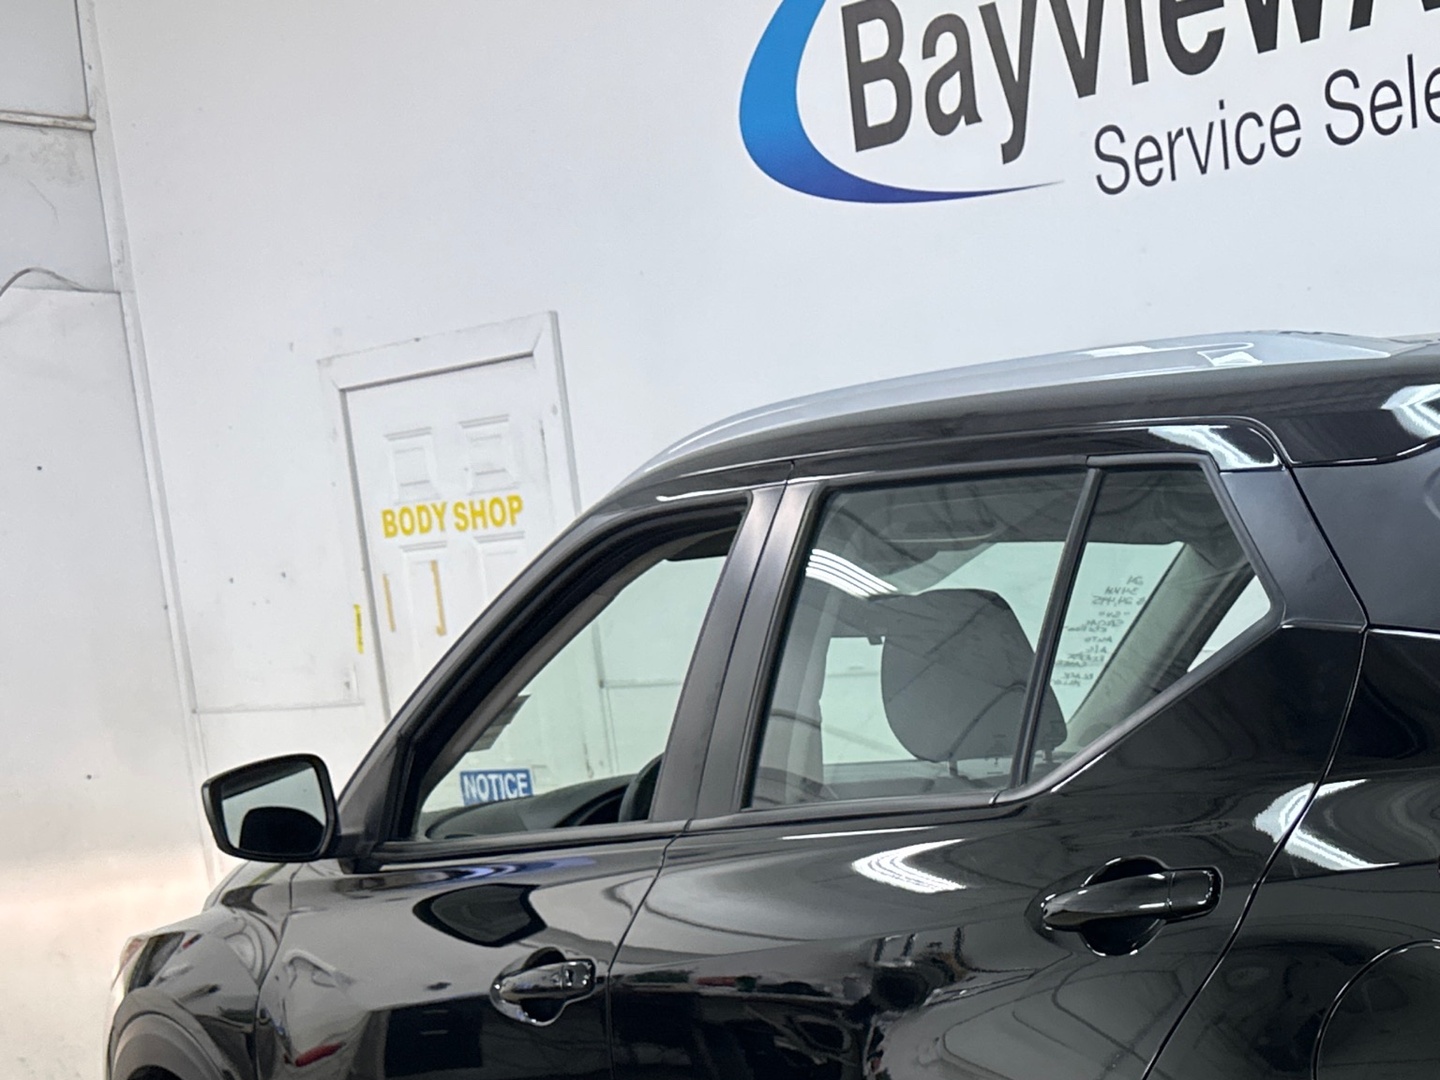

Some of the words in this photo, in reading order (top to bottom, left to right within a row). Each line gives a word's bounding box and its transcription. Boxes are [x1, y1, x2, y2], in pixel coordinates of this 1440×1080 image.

[1094, 99, 1301, 196] Service
[381, 502, 447, 538] BODY
[453, 494, 524, 532] SHOP
[462, 772, 529, 802] NOTICE
